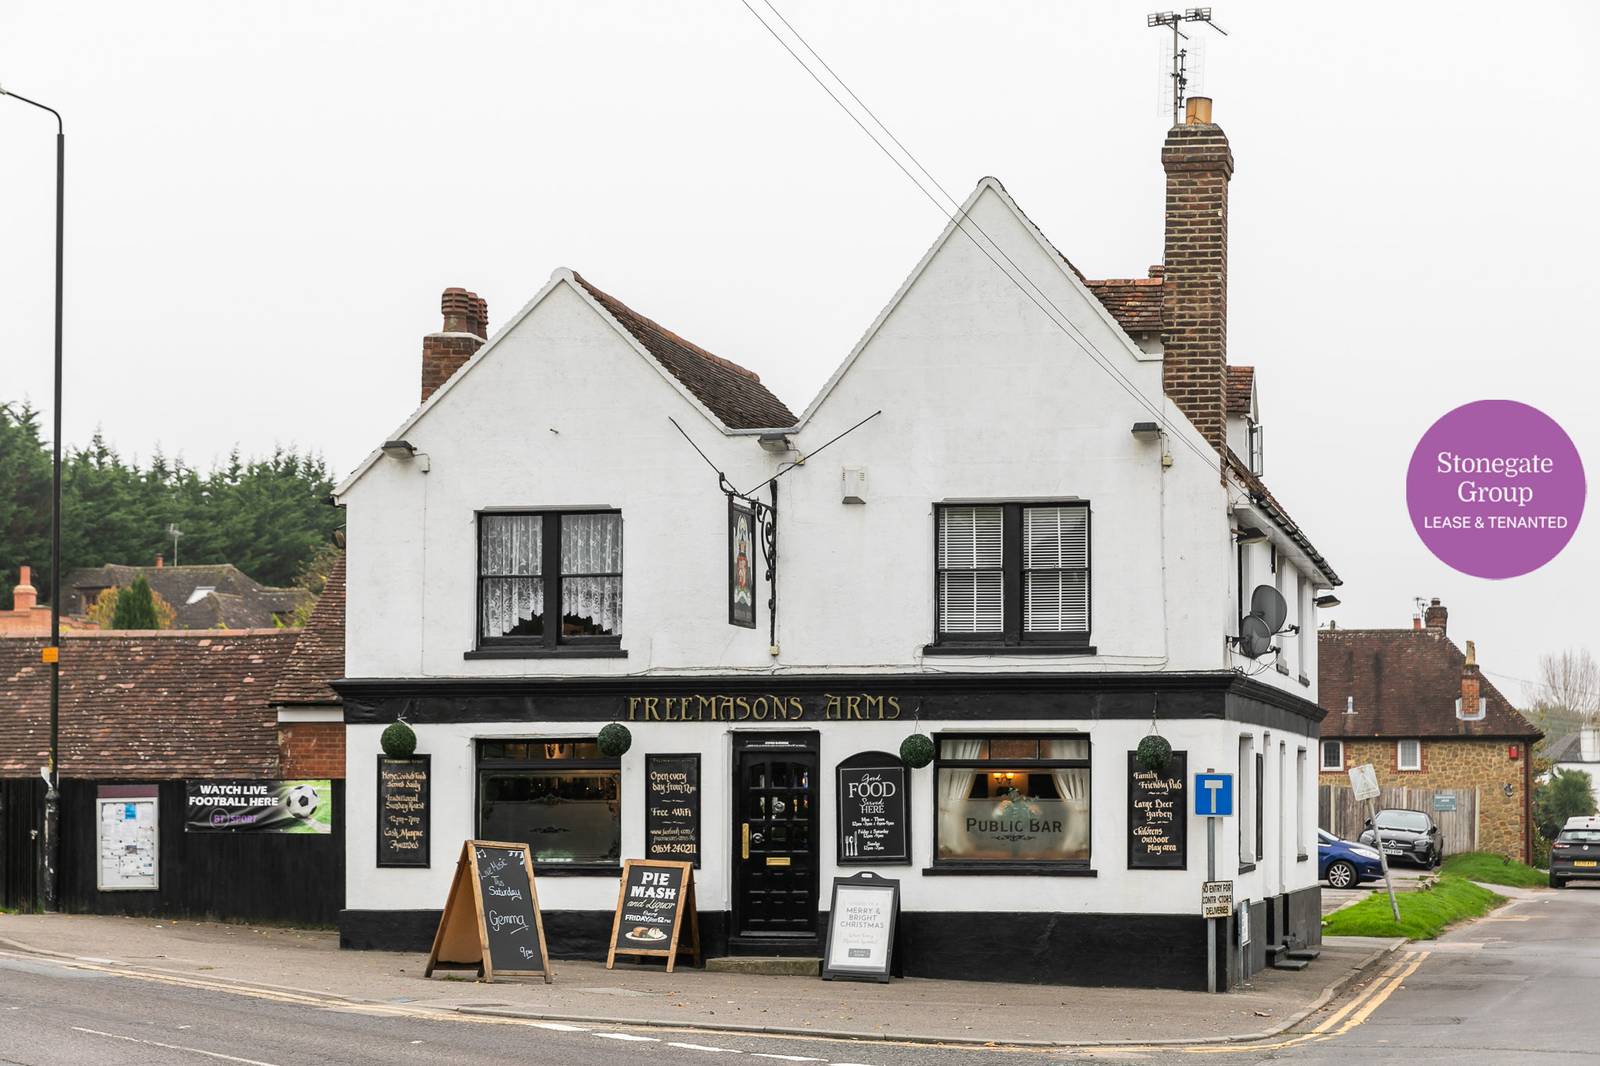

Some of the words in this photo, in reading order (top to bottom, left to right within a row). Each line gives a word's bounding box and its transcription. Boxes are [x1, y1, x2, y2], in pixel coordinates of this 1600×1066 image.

[629, 694, 803, 721] FREEMASONS
[824, 693, 901, 720] ARMS
[650, 771, 669, 783] Open
[669, 772, 687, 785] every
[862, 773, 882, 785] Good
[1133, 770, 1158, 780] Family
[200, 785, 240, 795] WATCH
[243, 785, 268, 795] LIVE
[665, 781, 684, 794] from
[848, 781, 896, 798] FOOD
[1139, 781, 1169, 793] Friendly
[1168, 778, 1182, 789] Pub
[189, 796, 248, 807] FOOTBALL
[249, 797, 279, 807] HERE
[1134, 799, 1153, 812] Large
[651, 807, 669, 817] Free
[861, 806, 885, 814] HERE
[1146, 808, 1173, 822] garden
[213, 815, 225, 824] BT
[230, 815, 257, 824] SPORT
[966, 817, 1023, 833] PUBLIC
[1029, 818, 1062, 833] BAR
[671, 843, 697, 854] 240211
[640, 871, 670, 886] PIE
[488, 885, 522, 900] Saturday
[630, 885, 676, 900] MASH
[1209, 884, 1223, 893] ENTRY
[1223, 883, 1232, 892] FOR
[627, 899, 647, 908] and
[645, 898, 676, 912] Liquor
[846, 906, 873, 915] MERRY
[1206, 905, 1229, 915] DELIVERIES
[489, 909, 528, 932] Gemma
[625, 914, 651, 923] FRIDAY
[840, 921, 884, 929] CHRISTMAS
